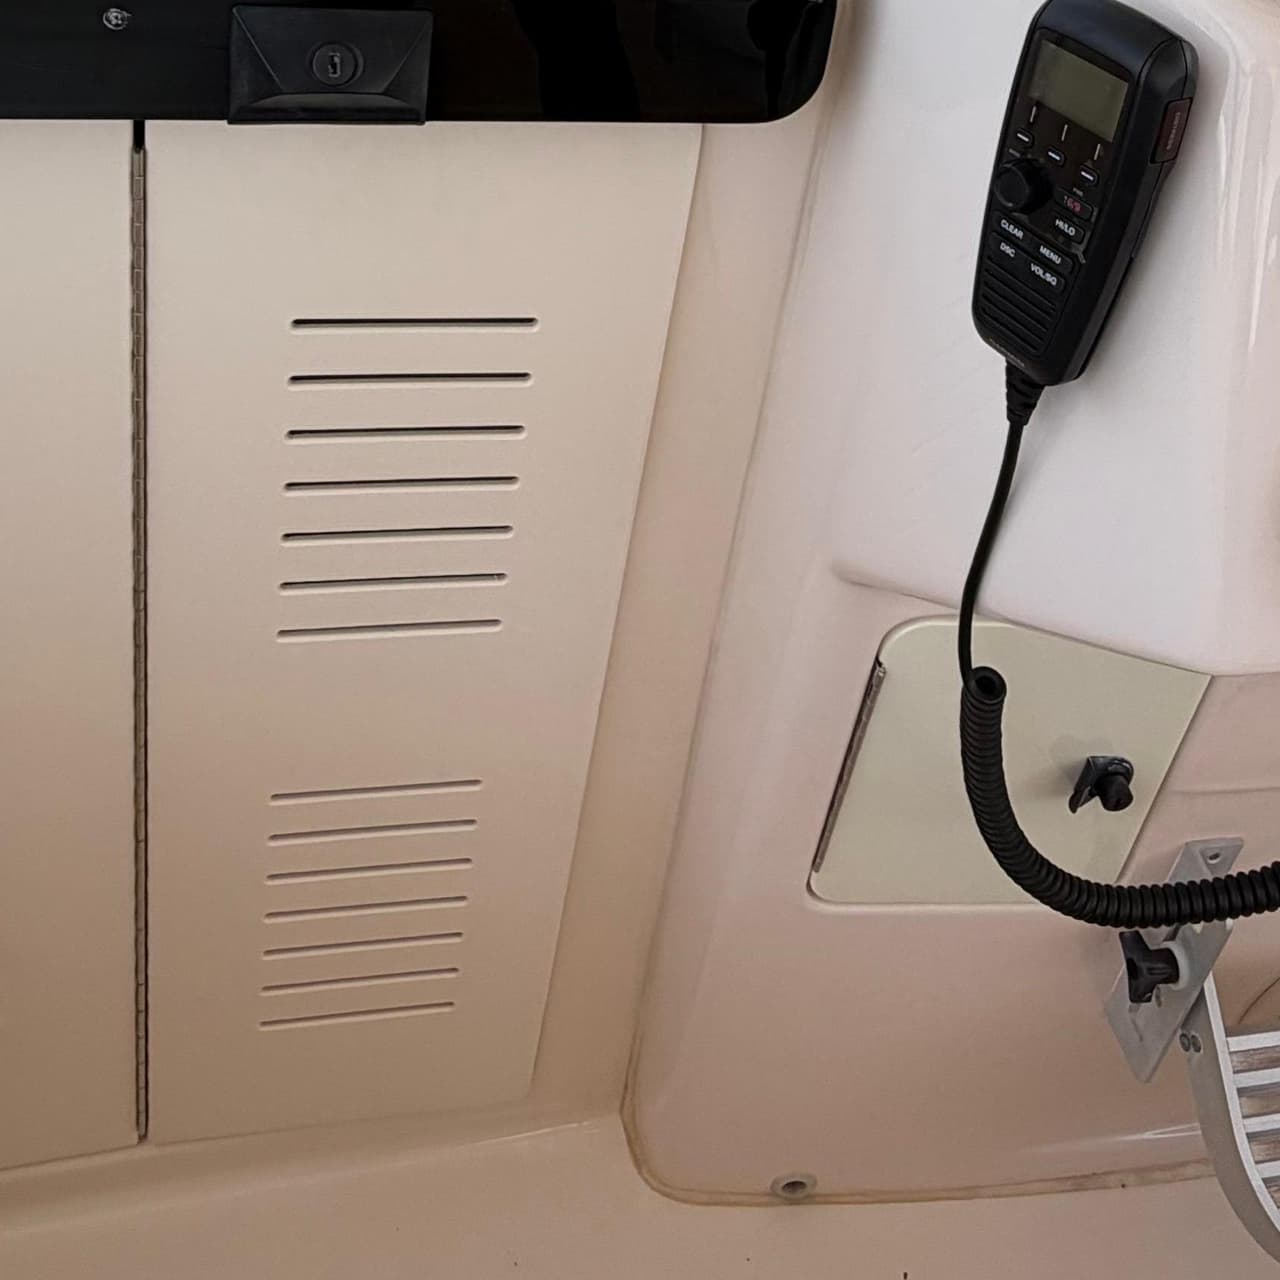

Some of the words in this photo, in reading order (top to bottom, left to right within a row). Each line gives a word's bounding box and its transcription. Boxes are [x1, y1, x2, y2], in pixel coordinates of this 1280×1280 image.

[1000, 219, 1024, 239] CLEAR
[999, 242, 1016, 258] DSC
[1039, 245, 1062, 265] MENU
